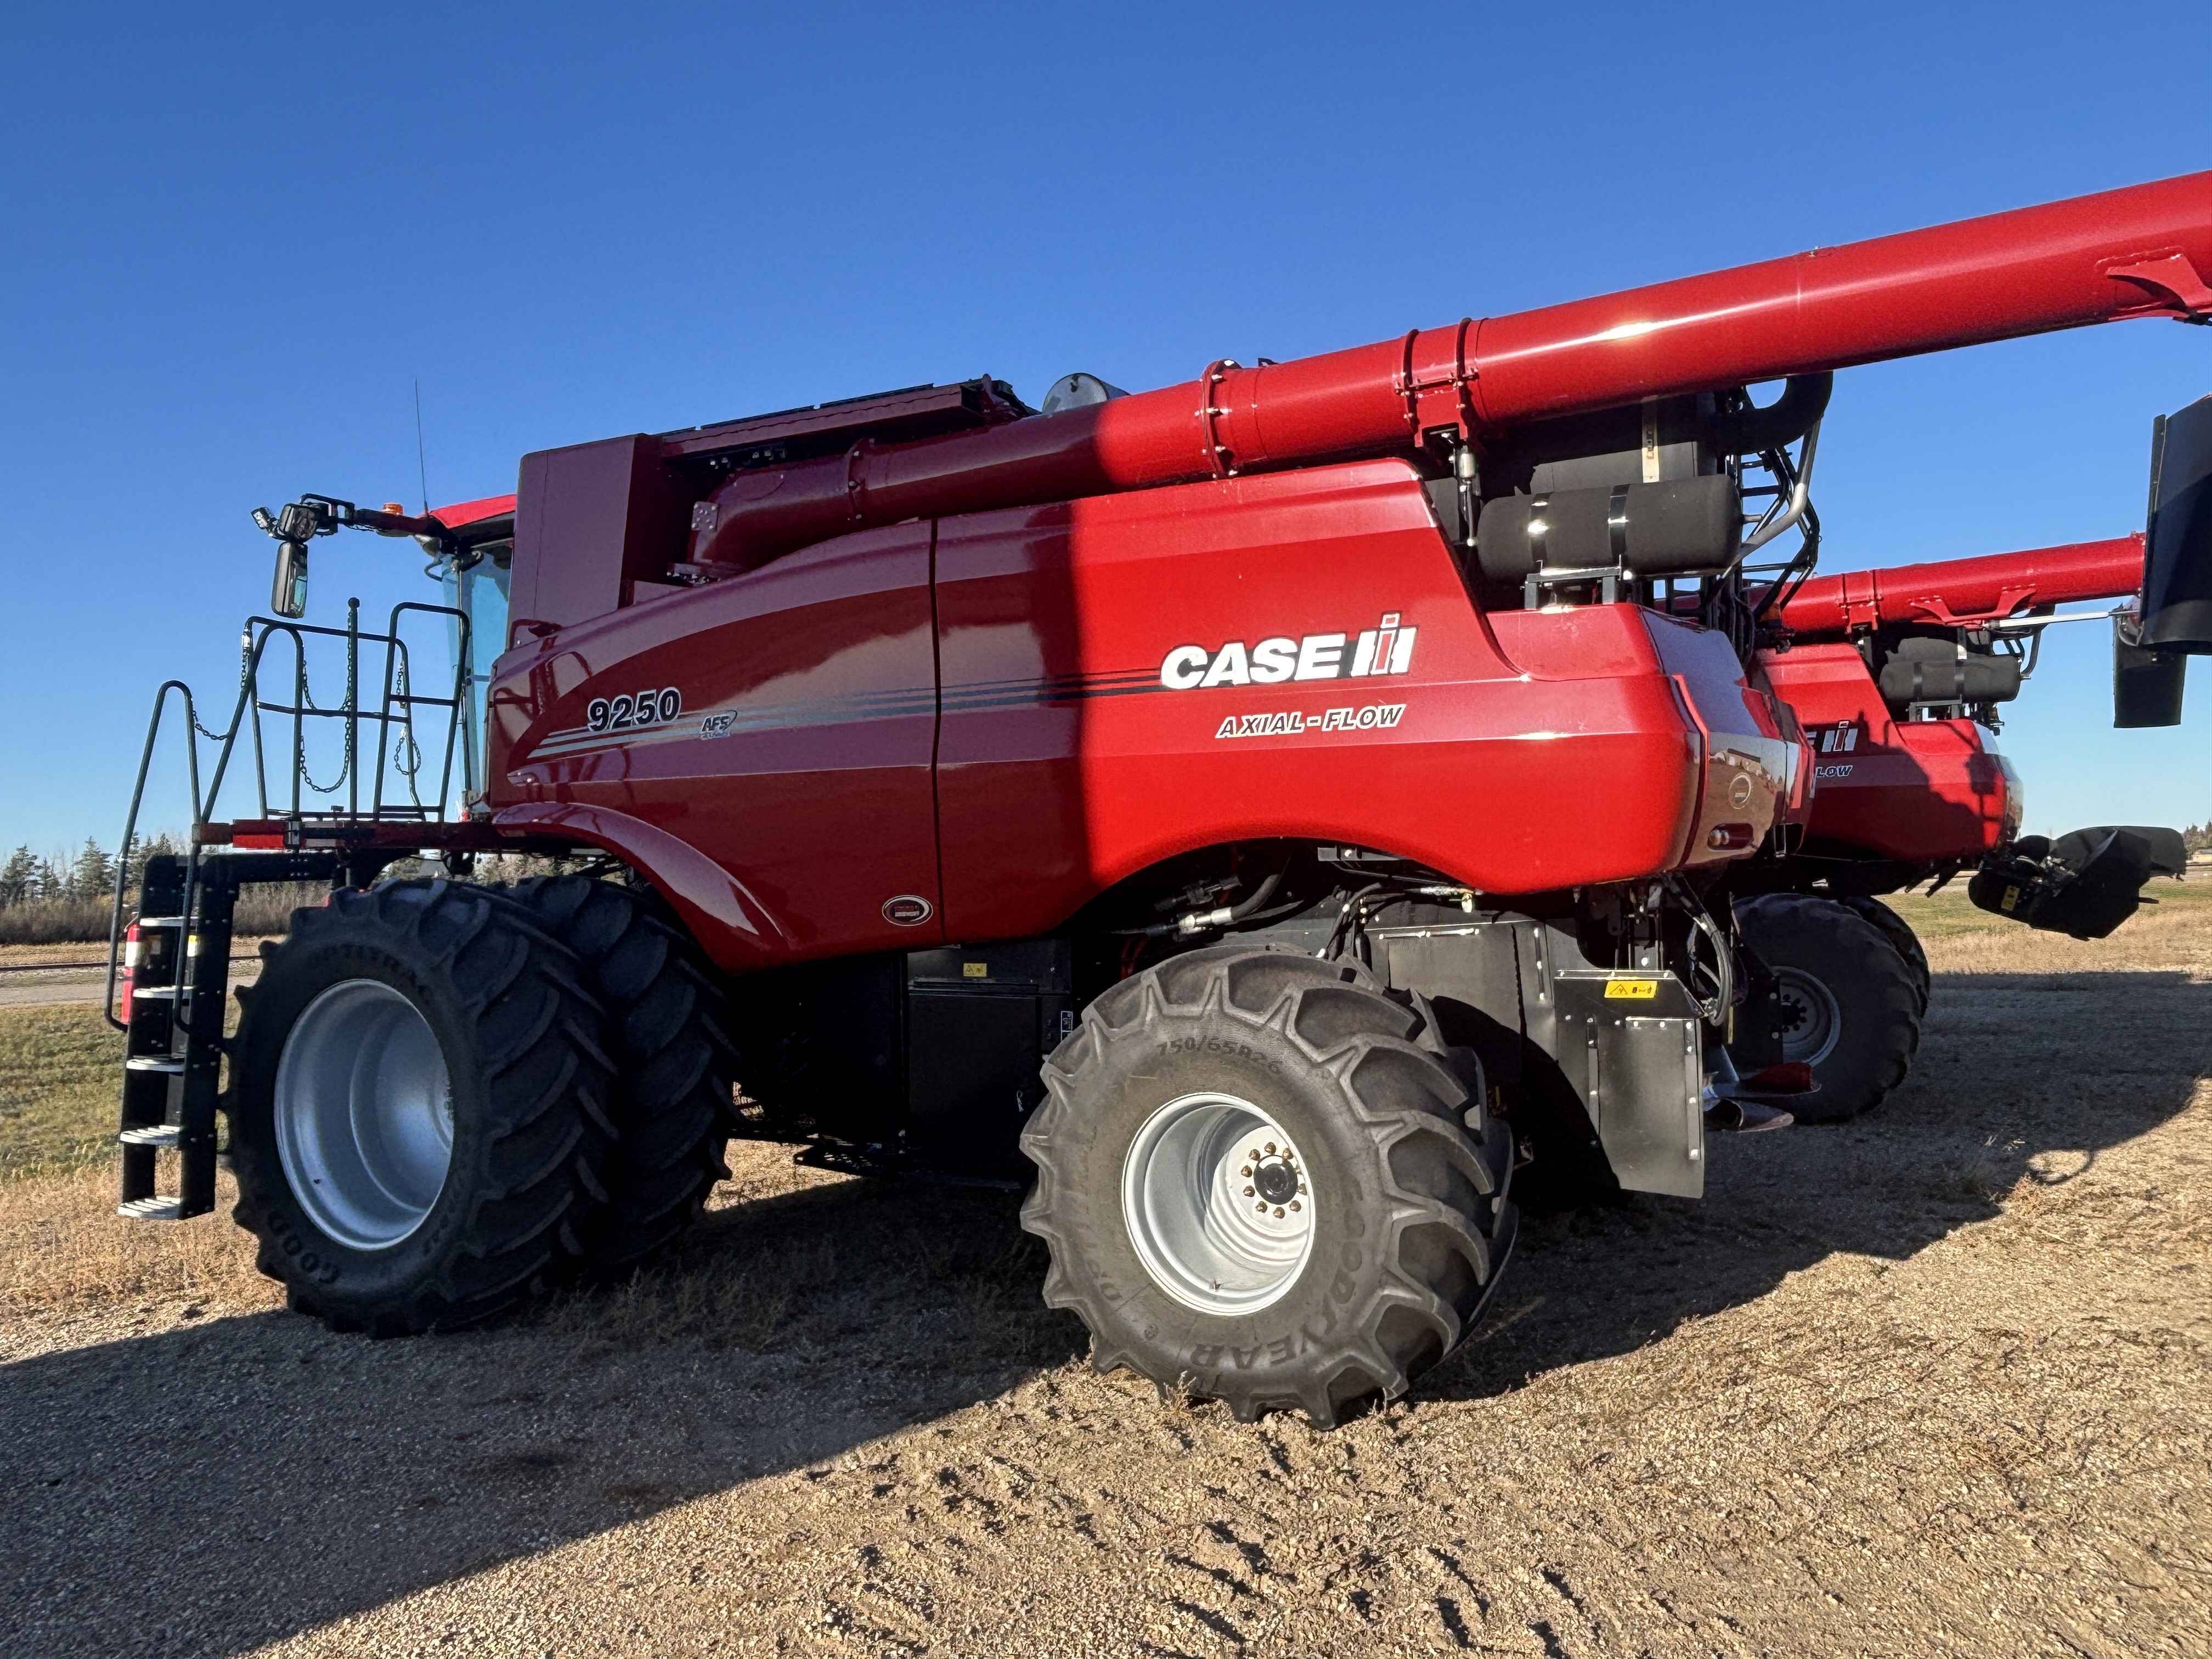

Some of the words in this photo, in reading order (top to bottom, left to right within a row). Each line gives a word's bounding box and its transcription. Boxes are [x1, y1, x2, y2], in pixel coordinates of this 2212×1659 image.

[1160, 633, 1346, 690] CASE
[588, 687, 681, 732] 9250
[701, 713, 731, 733] AFS
[1215, 704, 1407, 739] AXIAL-FLOW
